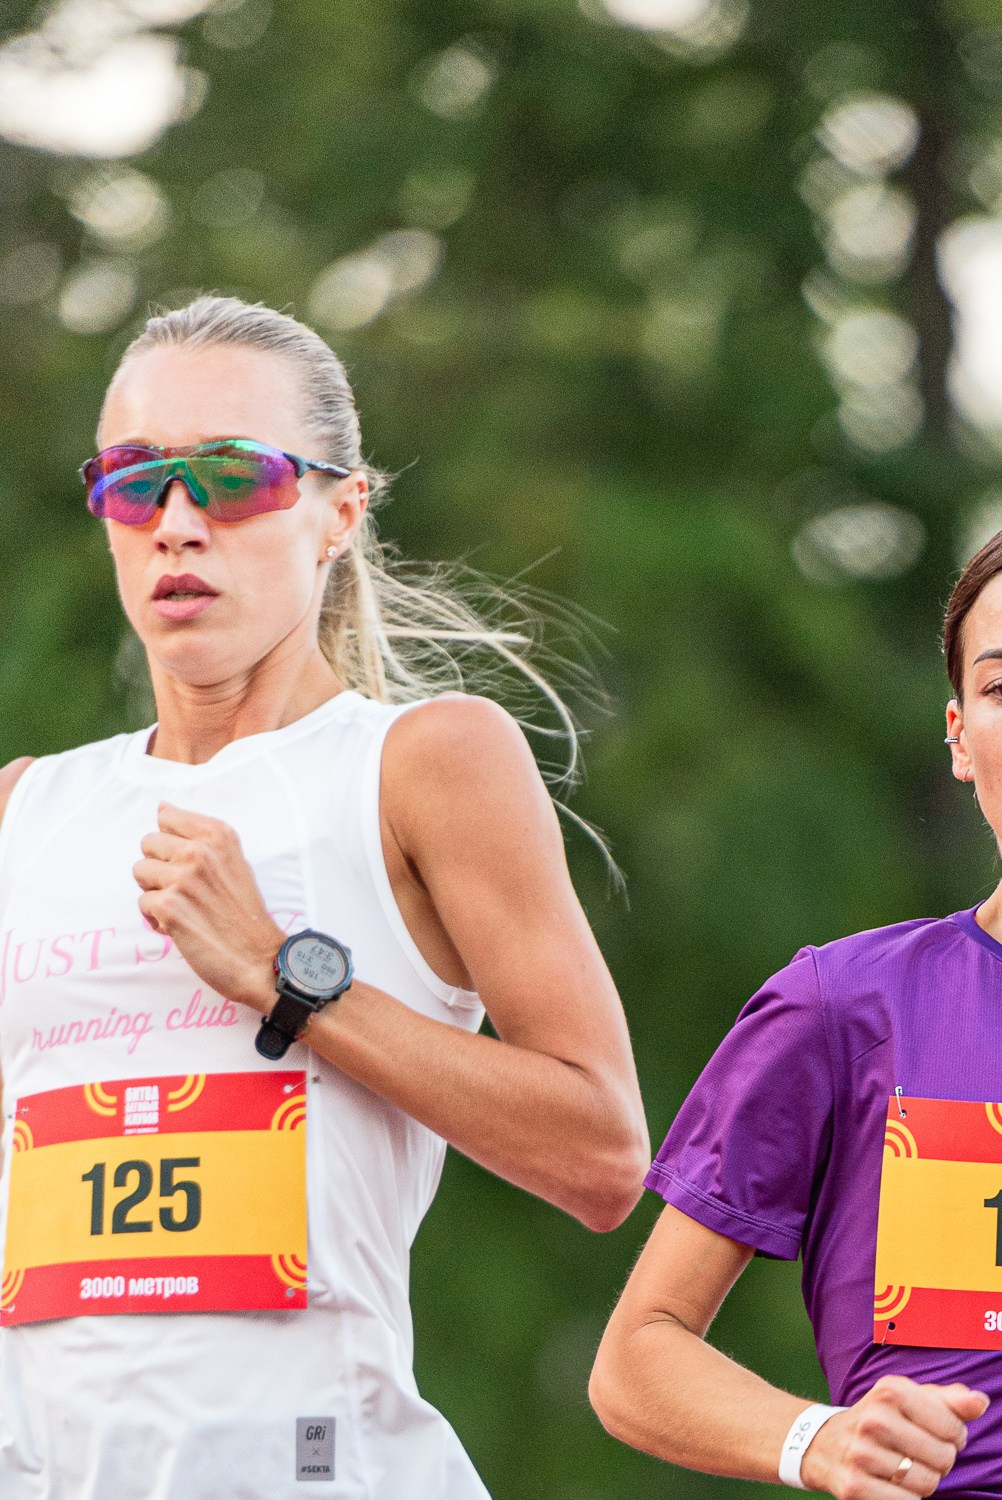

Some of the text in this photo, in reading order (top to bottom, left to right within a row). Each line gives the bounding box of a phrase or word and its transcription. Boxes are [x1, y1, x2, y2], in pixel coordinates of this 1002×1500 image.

[32, 988, 238, 1055] running club
[81, 1157, 201, 1236] 125
[80, 1276, 199, 1299] 3000 метров
[788, 1421, 811, 1453] 126
